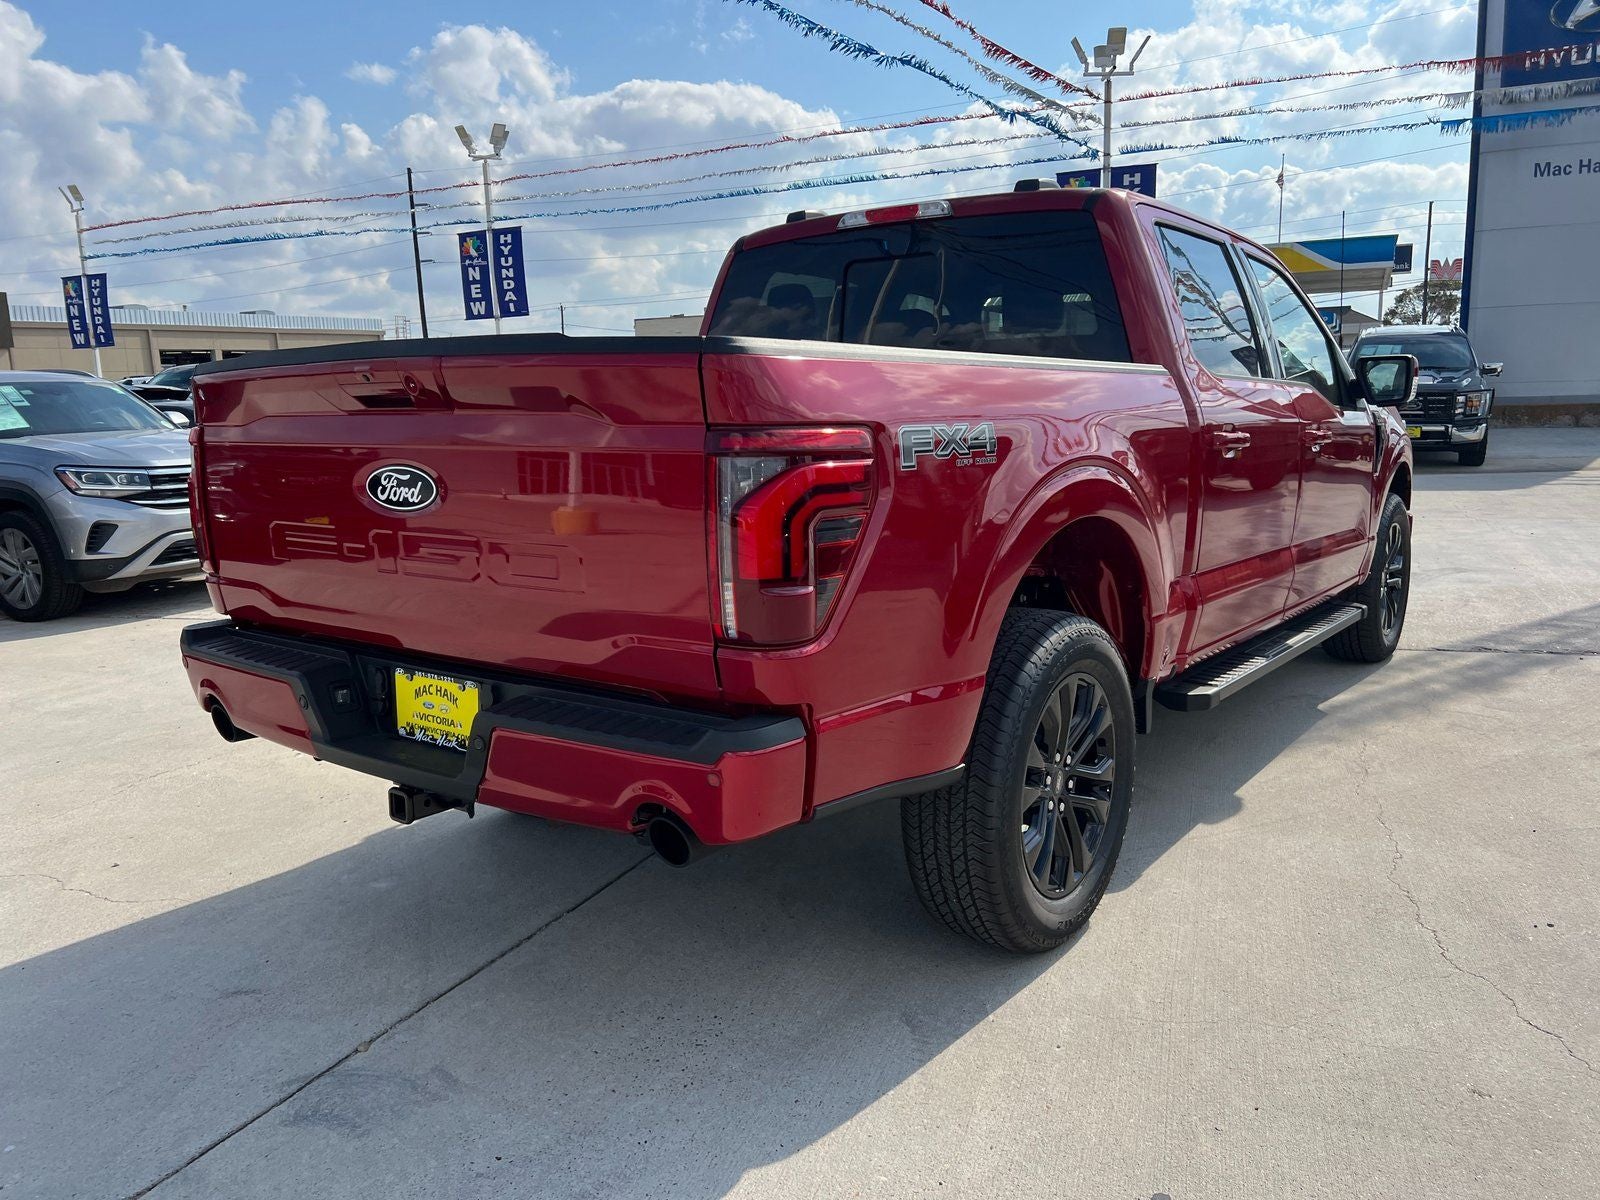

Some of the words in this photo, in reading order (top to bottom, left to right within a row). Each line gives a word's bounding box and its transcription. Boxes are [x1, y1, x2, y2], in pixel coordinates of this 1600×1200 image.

[1524, 42, 1600, 72] HYU
[1533, 161, 1572, 178] Mac
[468, 267, 486, 315] NEW
[500, 233, 517, 312] HYUNDAI
[69, 305, 85, 345] NEW
[91, 279, 105, 343] HYUNDAI
[898, 422, 997, 471] FX4
[378, 472, 422, 503] Ford
[269, 520, 586, 594] F-150
[414, 684, 434, 700] MAC
[435, 684, 459, 708] HAIK
[418, 712, 456, 728] VICTORIA
